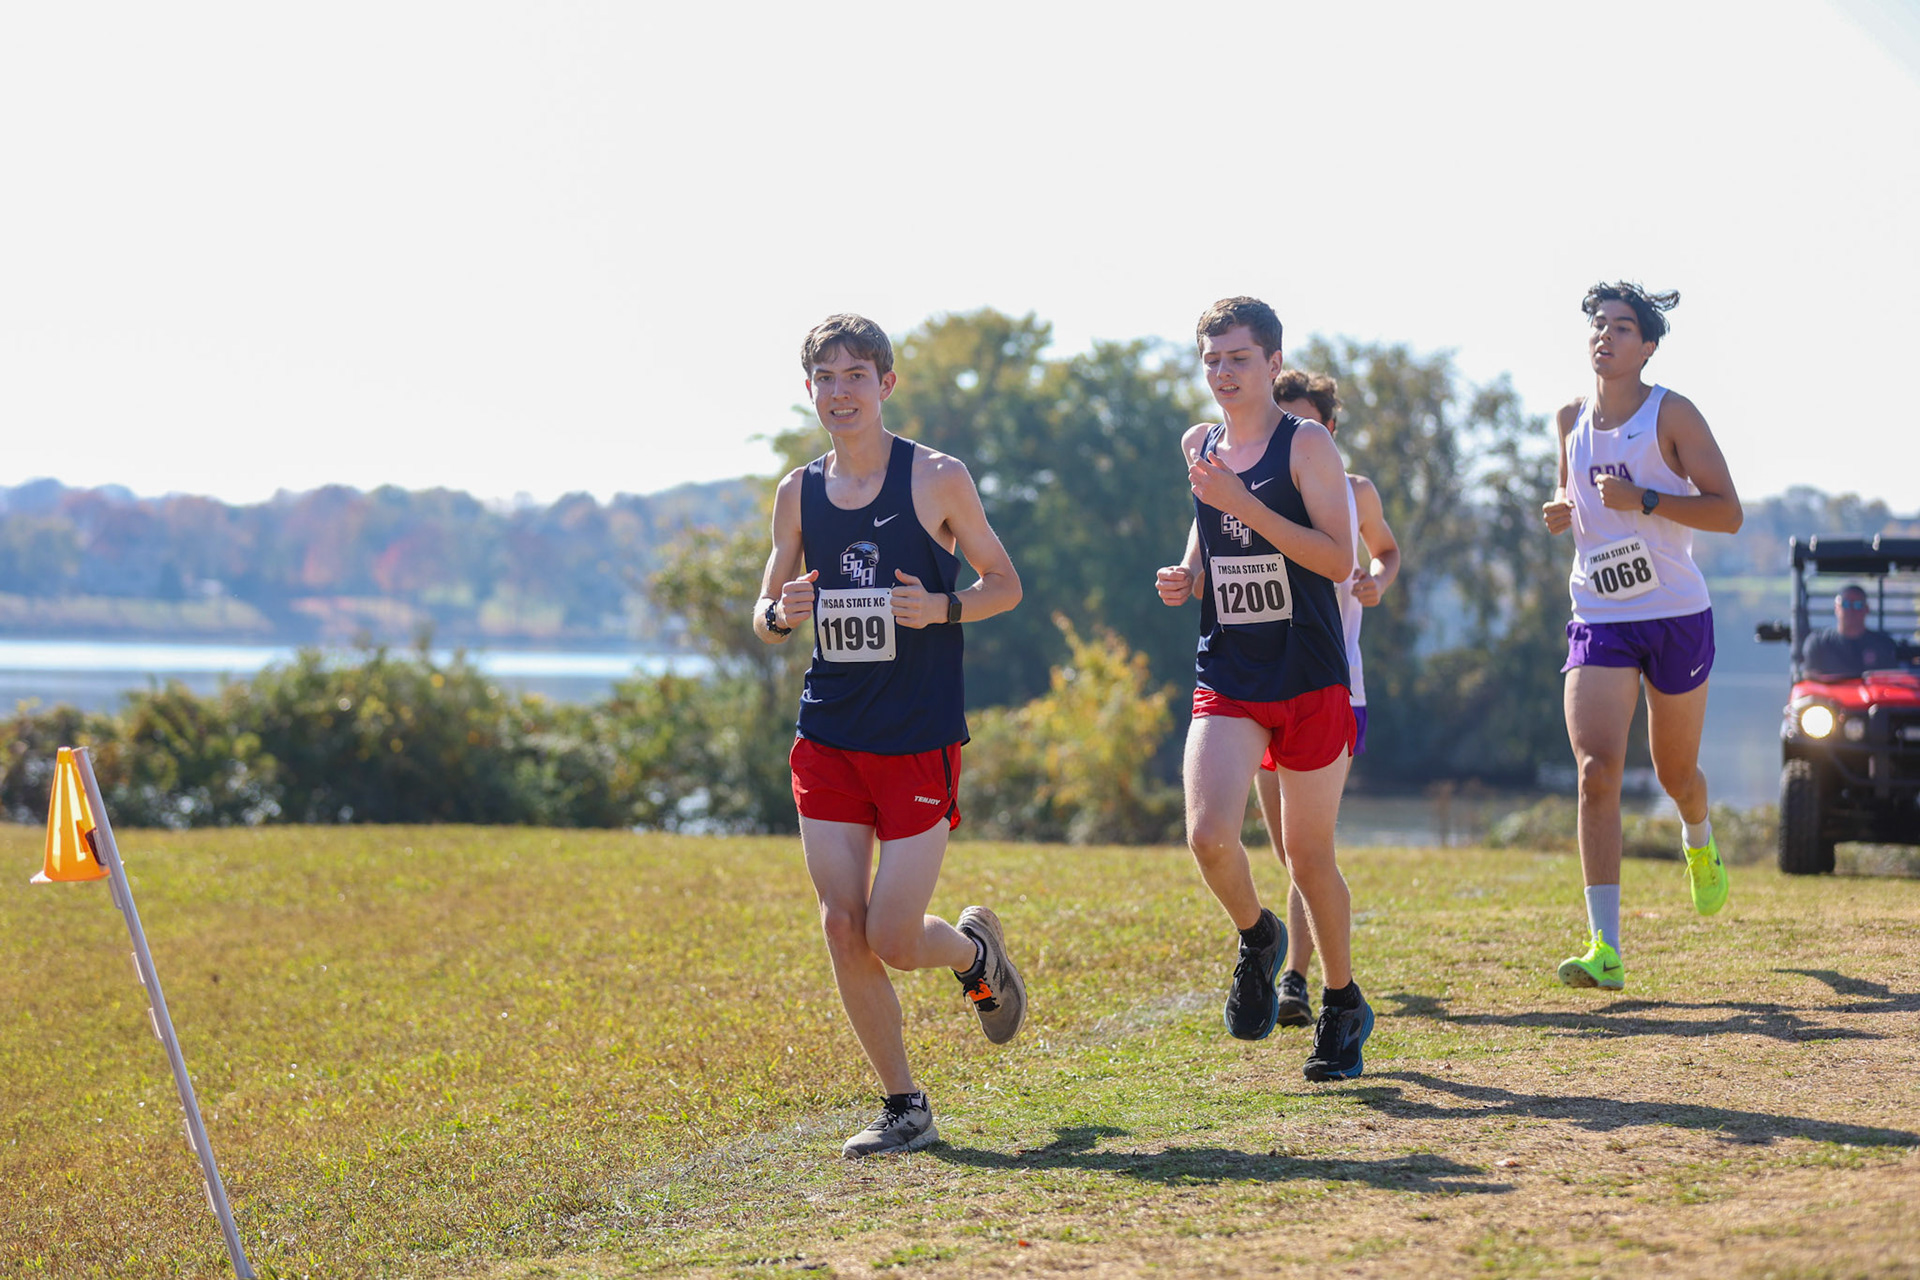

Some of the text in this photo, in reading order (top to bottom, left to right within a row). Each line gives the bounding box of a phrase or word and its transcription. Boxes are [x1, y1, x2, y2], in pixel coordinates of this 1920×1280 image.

[1223, 512, 1250, 546] SBA
[842, 553, 874, 587] SBA
[1217, 562, 1278, 575] TMSAA STATE XC
[1590, 542, 1641, 565] TMSAA STATE XC
[1590, 557, 1652, 595] 1068
[821, 597, 886, 609] TMSAA STATE XC
[1217, 579, 1286, 614] 1200
[821, 616, 886, 651] 1199
